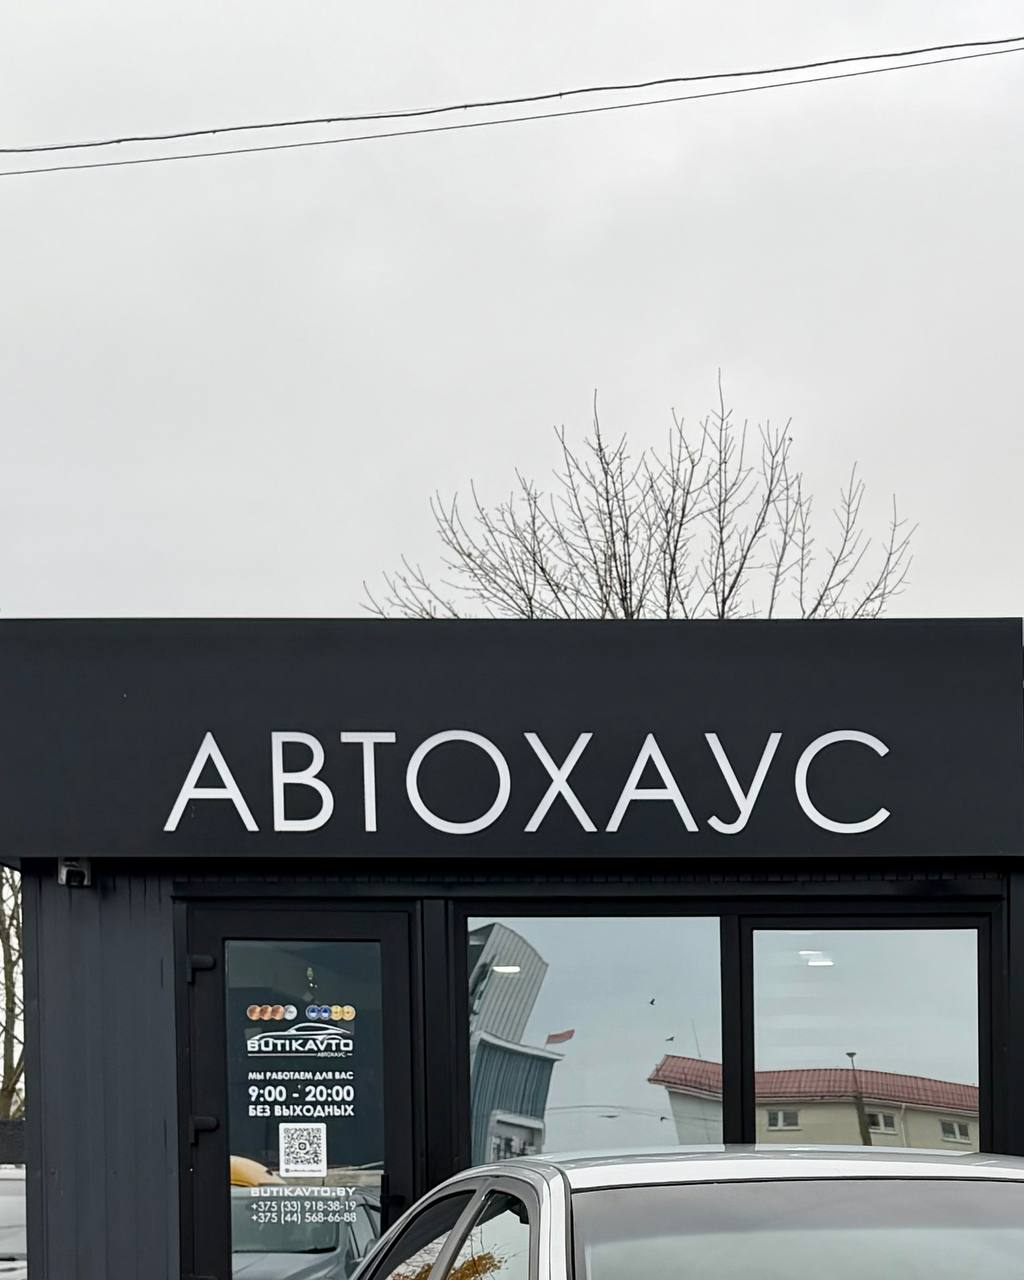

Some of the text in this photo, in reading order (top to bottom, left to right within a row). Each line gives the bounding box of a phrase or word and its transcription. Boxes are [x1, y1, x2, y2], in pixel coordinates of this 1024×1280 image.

[163, 729, 890, 835] АВТОХАУС
[247, 1039, 353, 1051] BUTIKAVTO
[248, 1072, 265, 1080] МЫ
[266, 1072, 313, 1080] РАБОТАЕМ
[334, 1072, 354, 1080] ВАС
[248, 1085, 287, 1101] 9:00
[304, 1085, 355, 1101] 20:00
[248, 1104, 355, 1118] БЕЗ ВЫХОДНЫХ
[250, 1187, 356, 1197] BUTIKAVTO.BY
[251, 1201, 357, 1213] +375 (33) 918-38-19
[251, 1212, 357, 1224] +375 (44) 568-66-88
